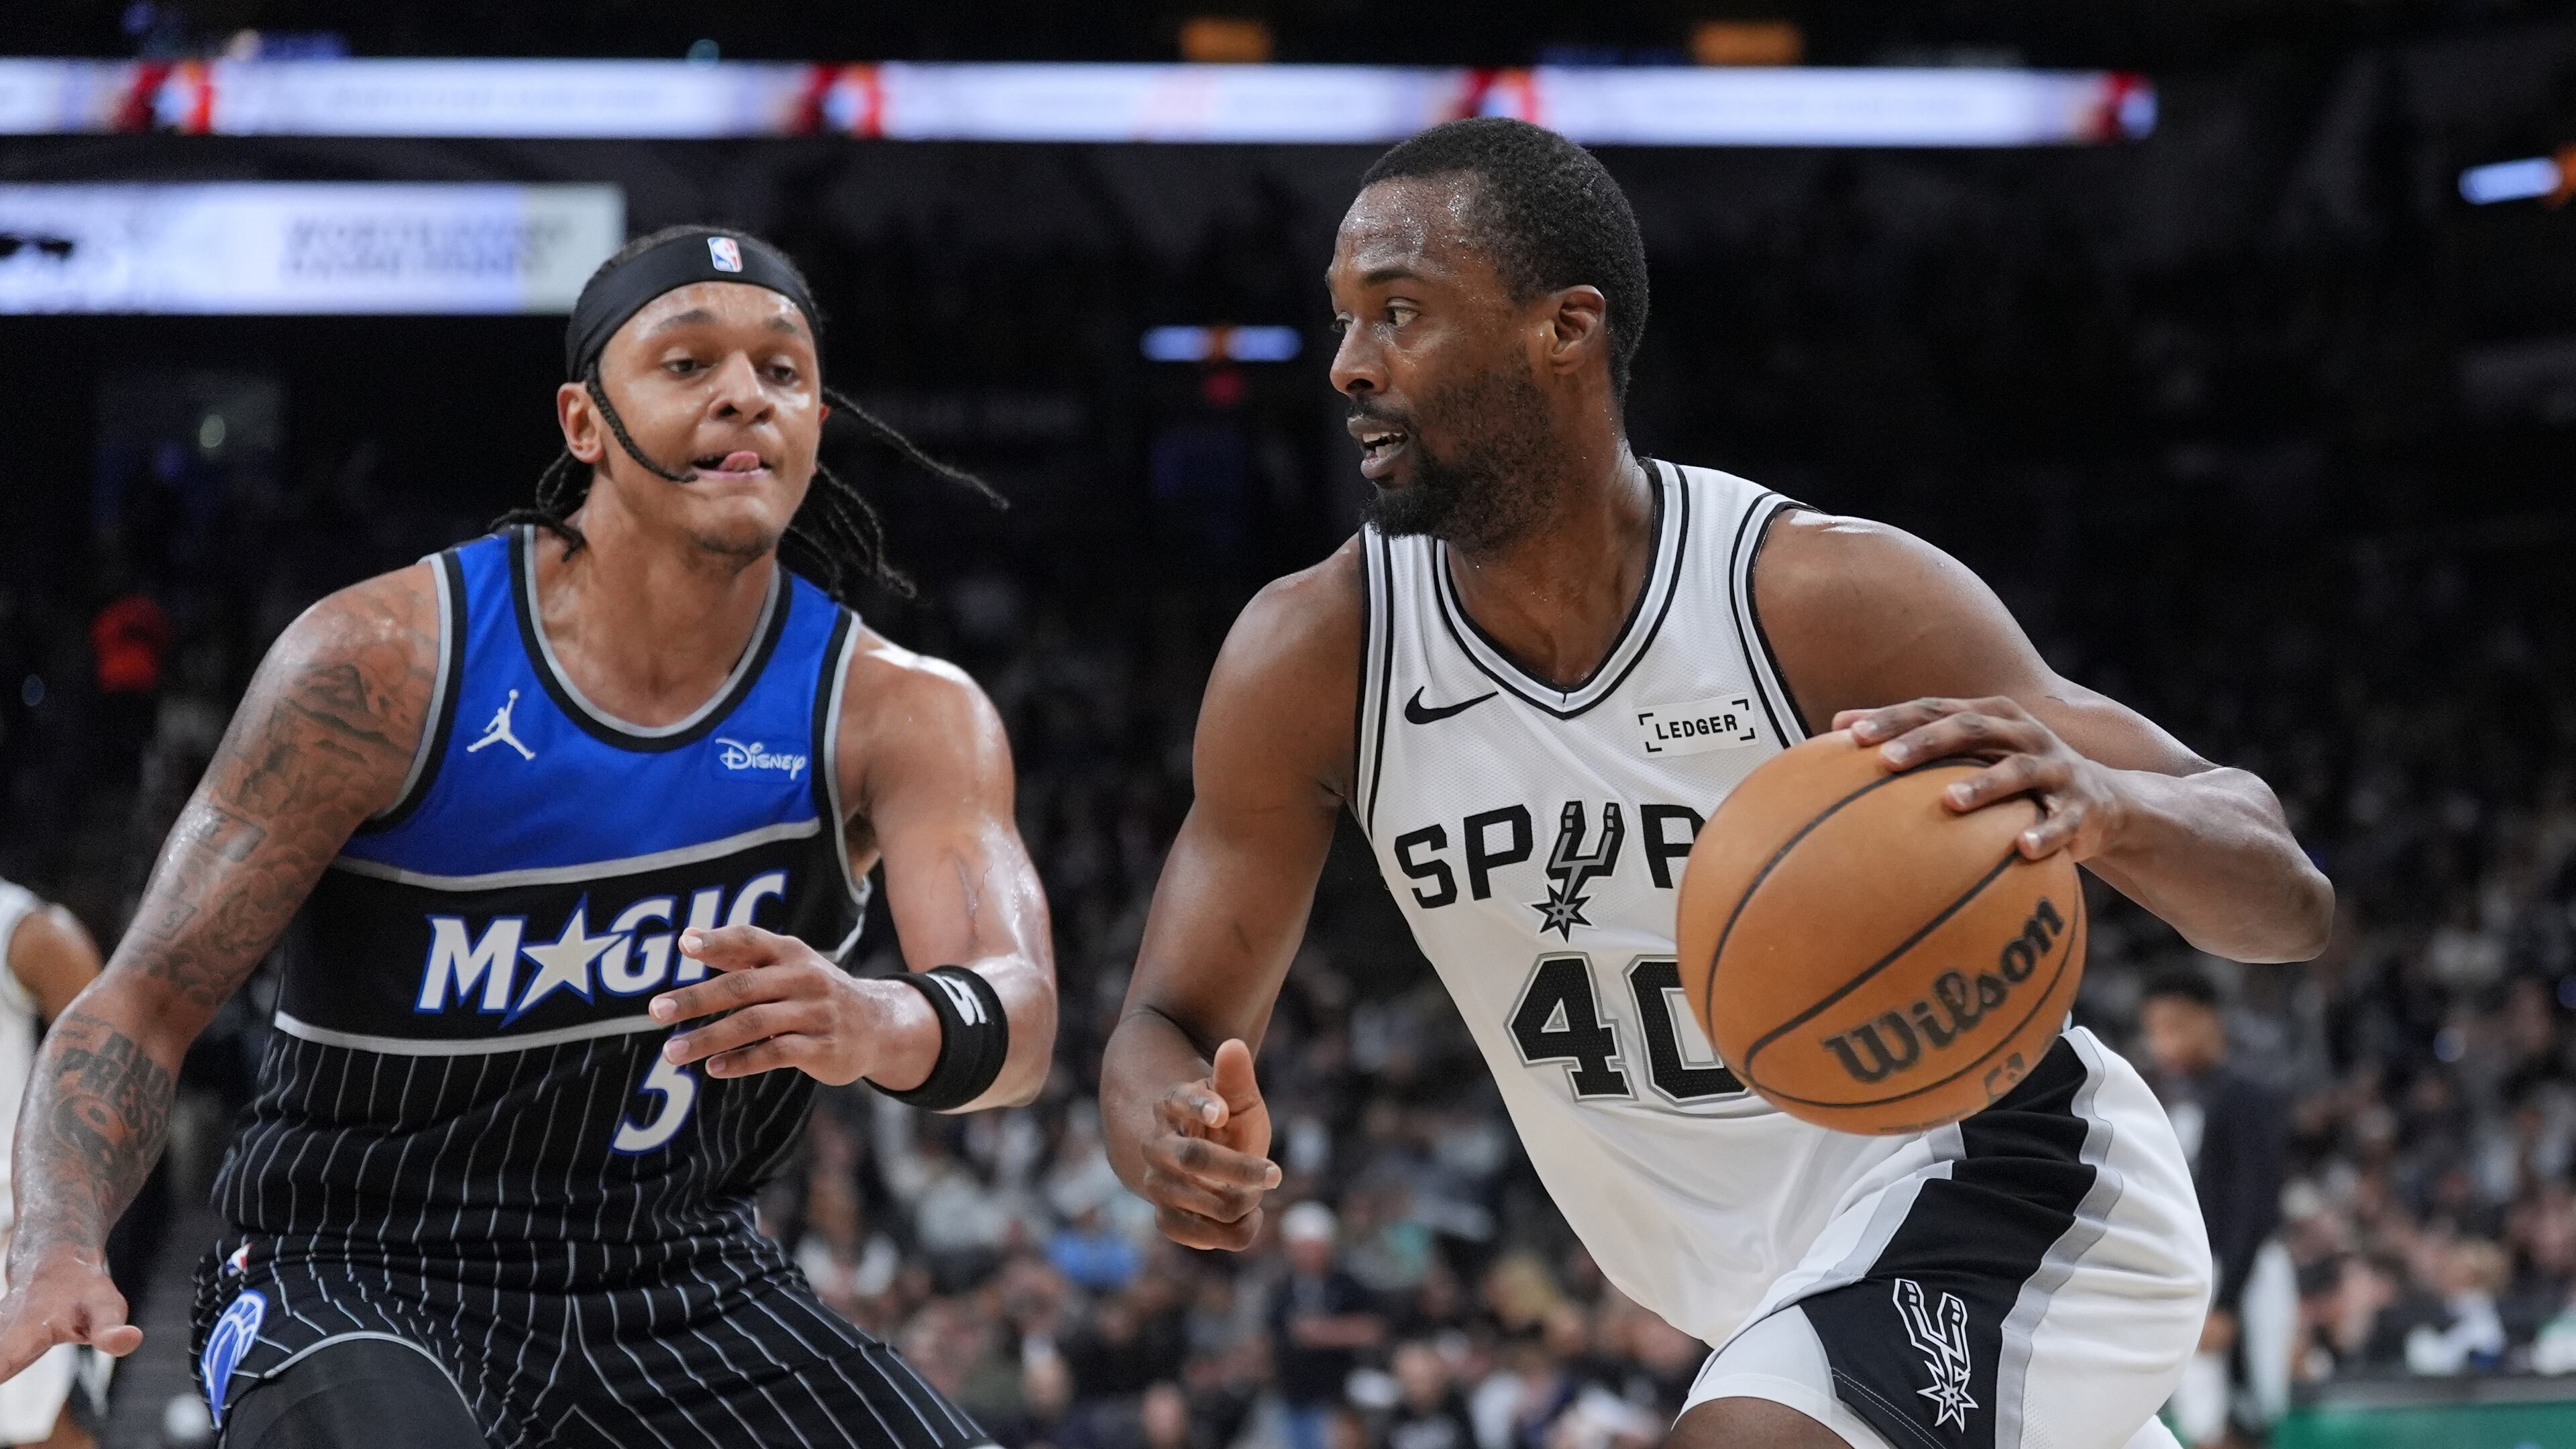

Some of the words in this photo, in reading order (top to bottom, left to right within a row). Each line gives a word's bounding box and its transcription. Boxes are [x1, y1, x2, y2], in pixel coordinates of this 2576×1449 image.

[715, 738, 806, 780] Disney
[1655, 714, 1738, 740] LEDGER
[1821, 897, 2064, 1085] Wilson
[608, 1028, 700, 1156] 5
